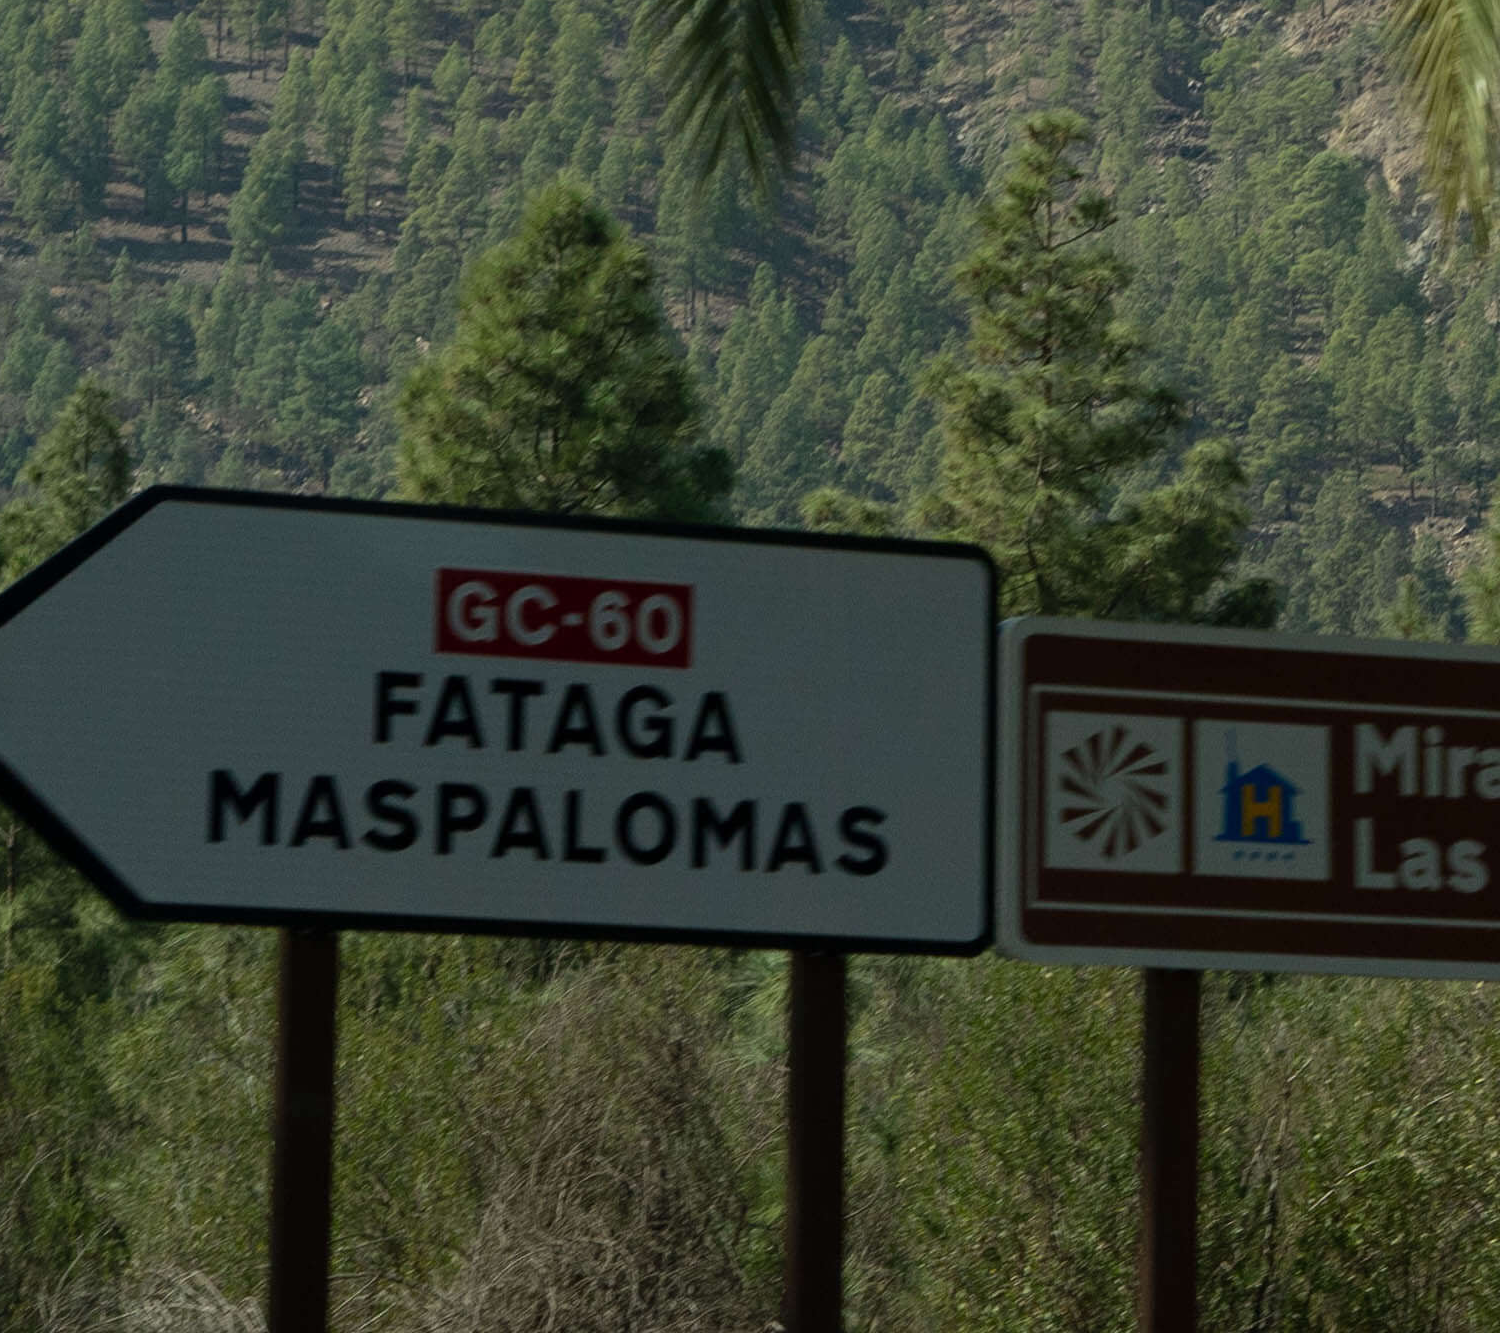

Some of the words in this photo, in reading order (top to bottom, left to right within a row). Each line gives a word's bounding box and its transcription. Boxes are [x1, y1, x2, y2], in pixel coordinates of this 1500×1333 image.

[446, 579, 684, 653] GC-60
[372, 670, 745, 764] FATAGA
[206, 767, 890, 876] MASPALOMAS
[1241, 784, 1283, 838] H
[1352, 817, 1490, 894] Las
